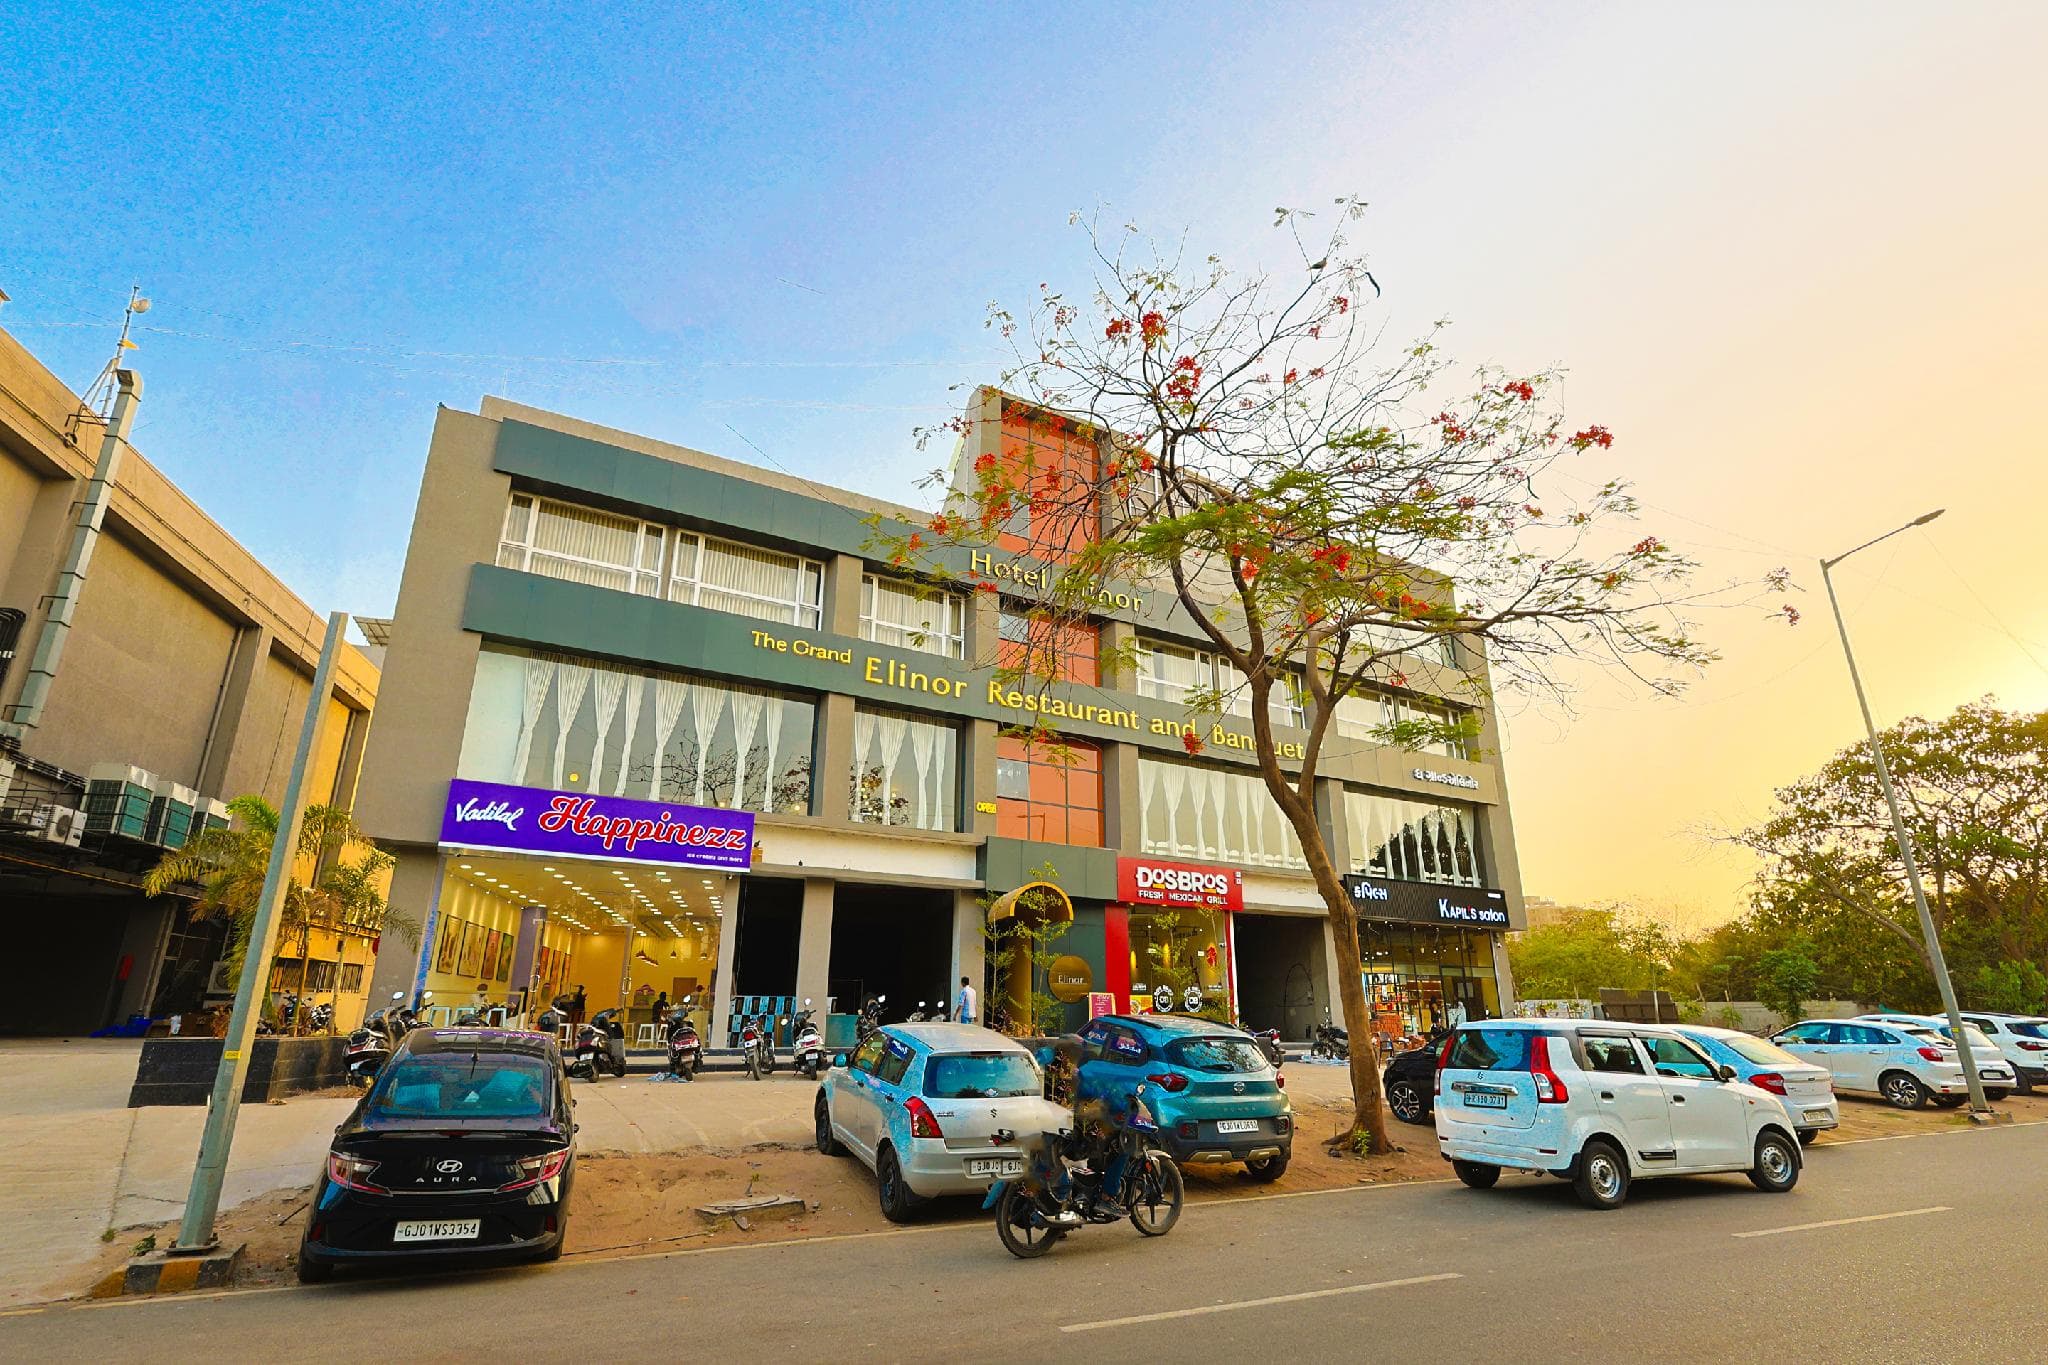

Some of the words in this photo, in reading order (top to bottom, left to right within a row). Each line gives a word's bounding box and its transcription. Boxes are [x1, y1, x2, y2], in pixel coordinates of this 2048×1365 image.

[970, 550, 1046, 590] Hotel
[751, 630, 787, 652] The
[793, 640, 852, 665] Grand
[865, 656, 968, 698] Elinor
[987, 680, 1140, 730] Restaurant
[1150, 716, 1197, 738] and
[1212, 723, 1306, 761] Banuet
[456, 797, 524, 831] Vadilal
[538, 796, 747, 852] Happinezz
[1135, 866, 1228, 895] DOSBROS
[1138, 889, 1164, 899] FRESH
[1168, 892, 1203, 903] MEXICAN
[1206, 895, 1228, 905] GRILL
[1479, 908, 1506, 922] salon
